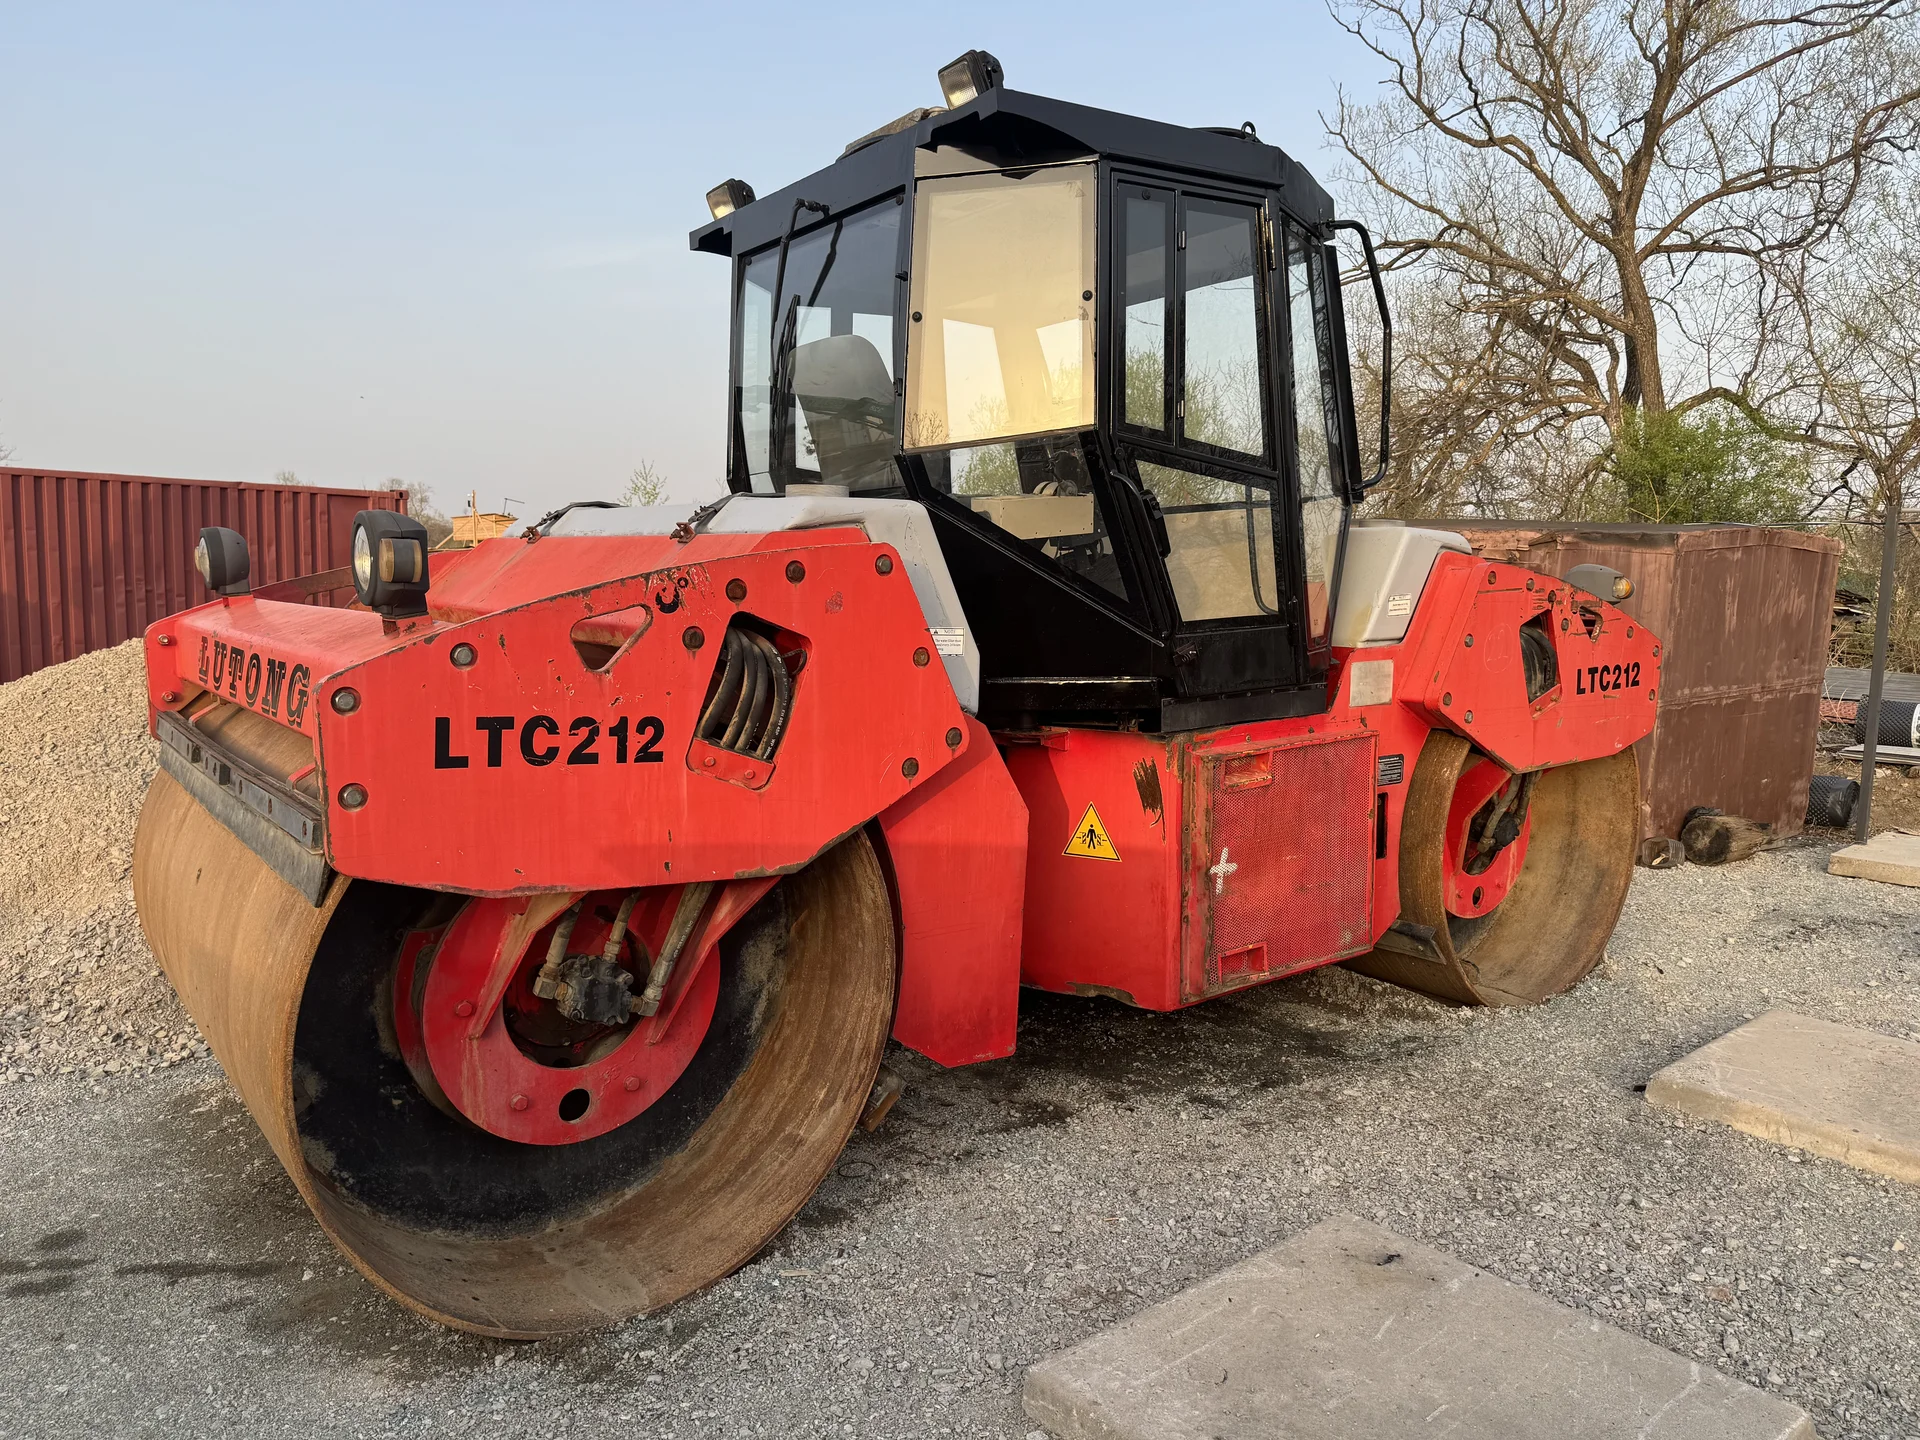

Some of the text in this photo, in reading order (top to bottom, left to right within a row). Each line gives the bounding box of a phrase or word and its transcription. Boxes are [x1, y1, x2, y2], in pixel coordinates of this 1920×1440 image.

[198, 635, 311, 729] LUTONG
[1576, 661, 1640, 695] LTC212
[434, 715, 665, 770] LTC212
